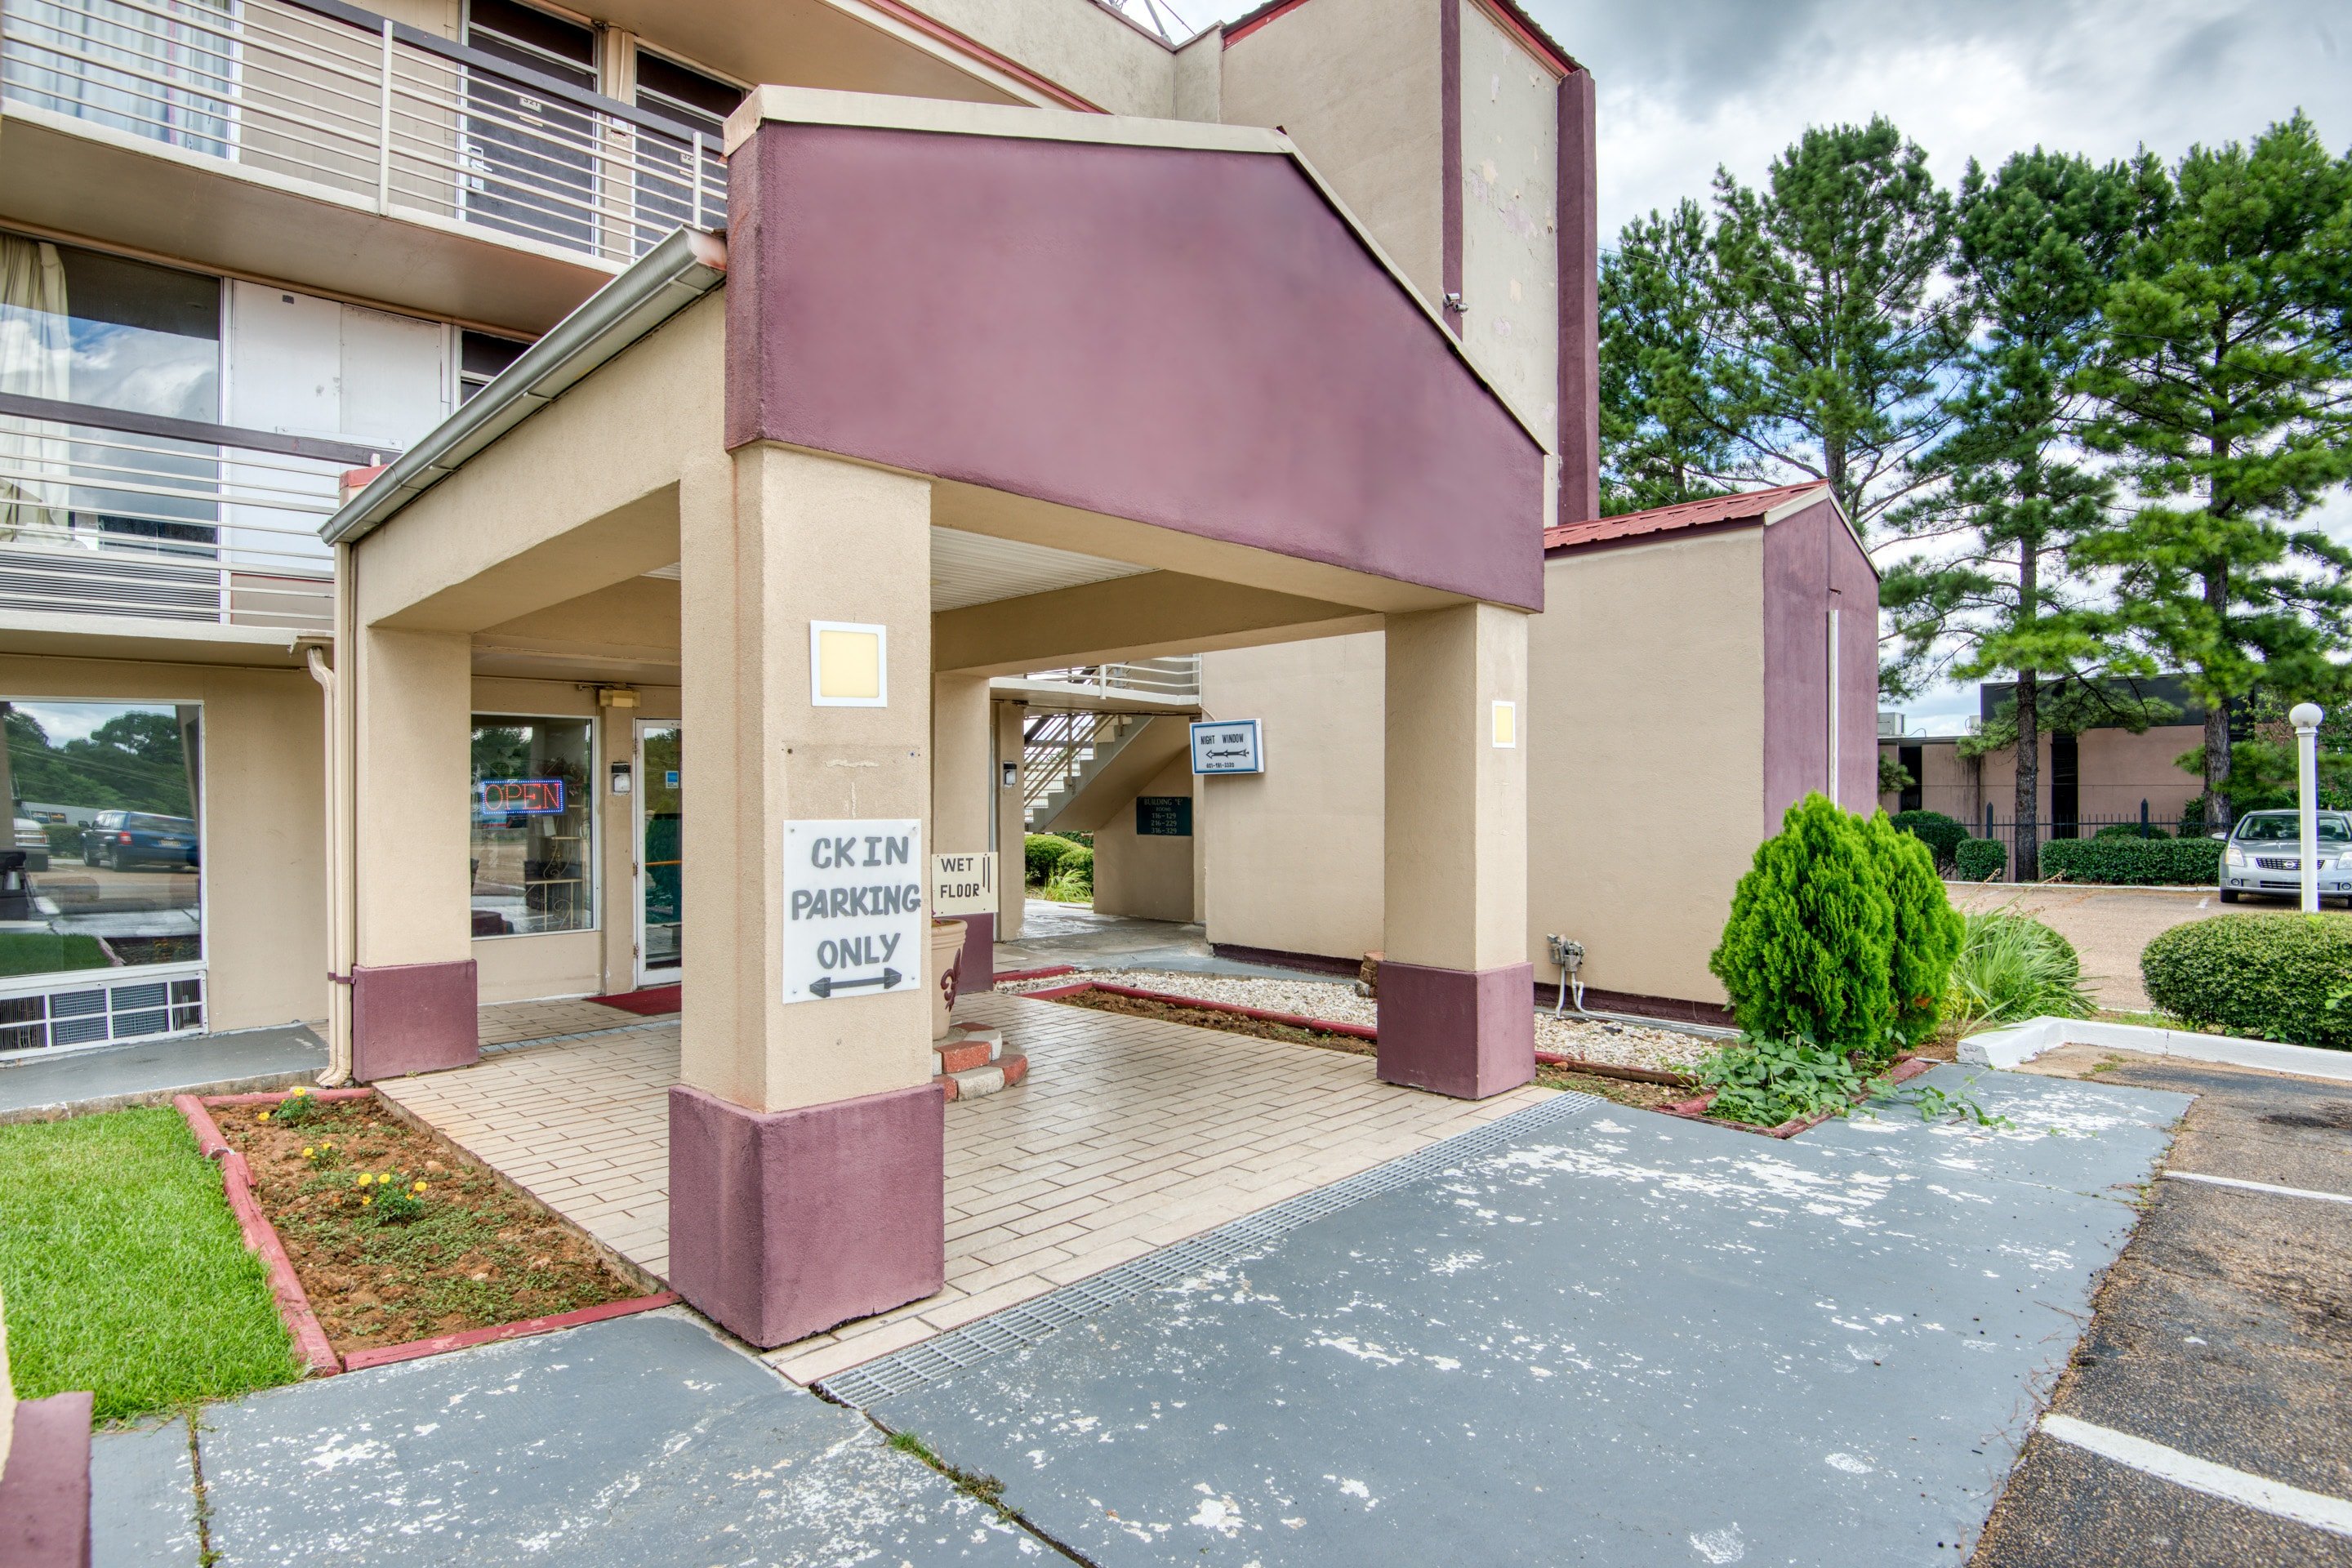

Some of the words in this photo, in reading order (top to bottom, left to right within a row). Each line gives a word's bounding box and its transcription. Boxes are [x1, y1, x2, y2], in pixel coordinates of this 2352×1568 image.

[1200, 735, 1215, 745] NIGHT
[1222, 733, 1244, 744] WINDOW
[484, 783, 560, 810] OPEN
[940, 858, 973, 872] WET
[940, 884, 980, 898] FLOOR
[791, 884, 921, 920] PARKING
[817, 933, 901, 969] ONLY
